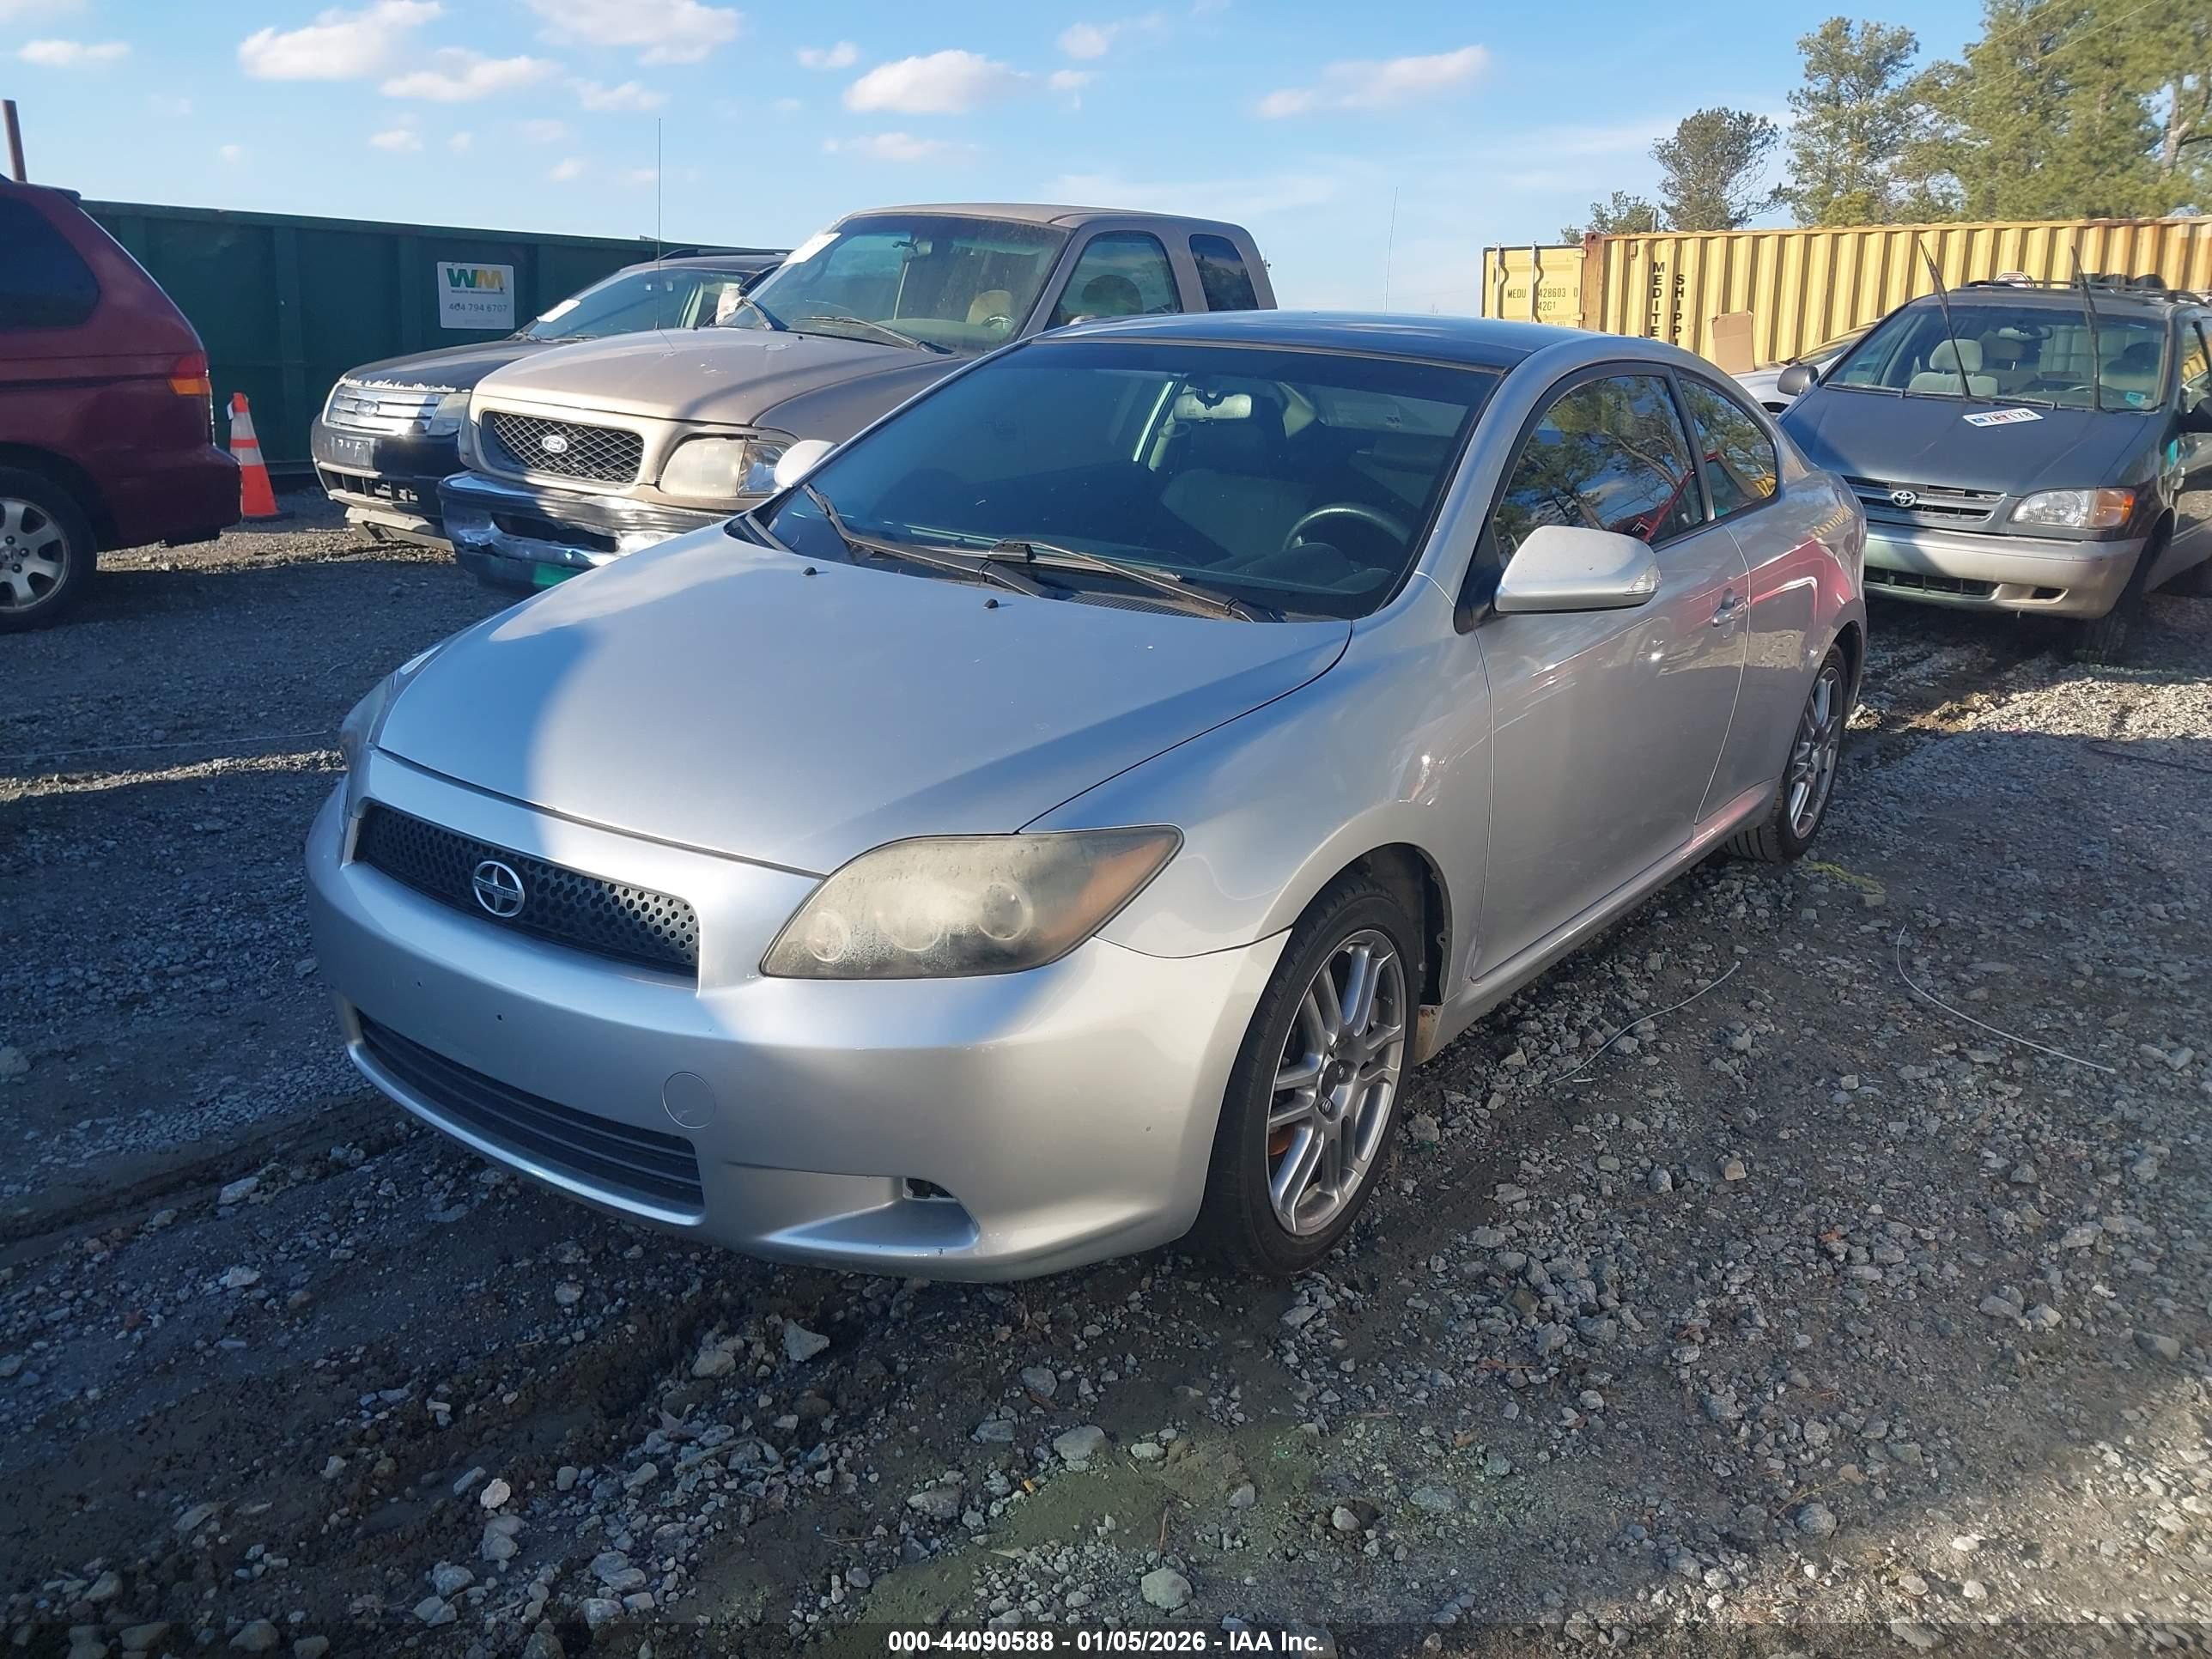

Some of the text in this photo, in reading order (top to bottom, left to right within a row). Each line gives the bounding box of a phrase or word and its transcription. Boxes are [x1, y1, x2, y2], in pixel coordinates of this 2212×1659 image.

[447, 267, 505, 289] WM
[1507, 288, 1527, 299] MEDU
[1538, 288, 1566, 298] 428603
[1538, 301, 1556, 312] 42G1
[1650, 261, 1666, 341] MEDITE
[447, 302, 466, 312] 404
[467, 303, 484, 313] 794
